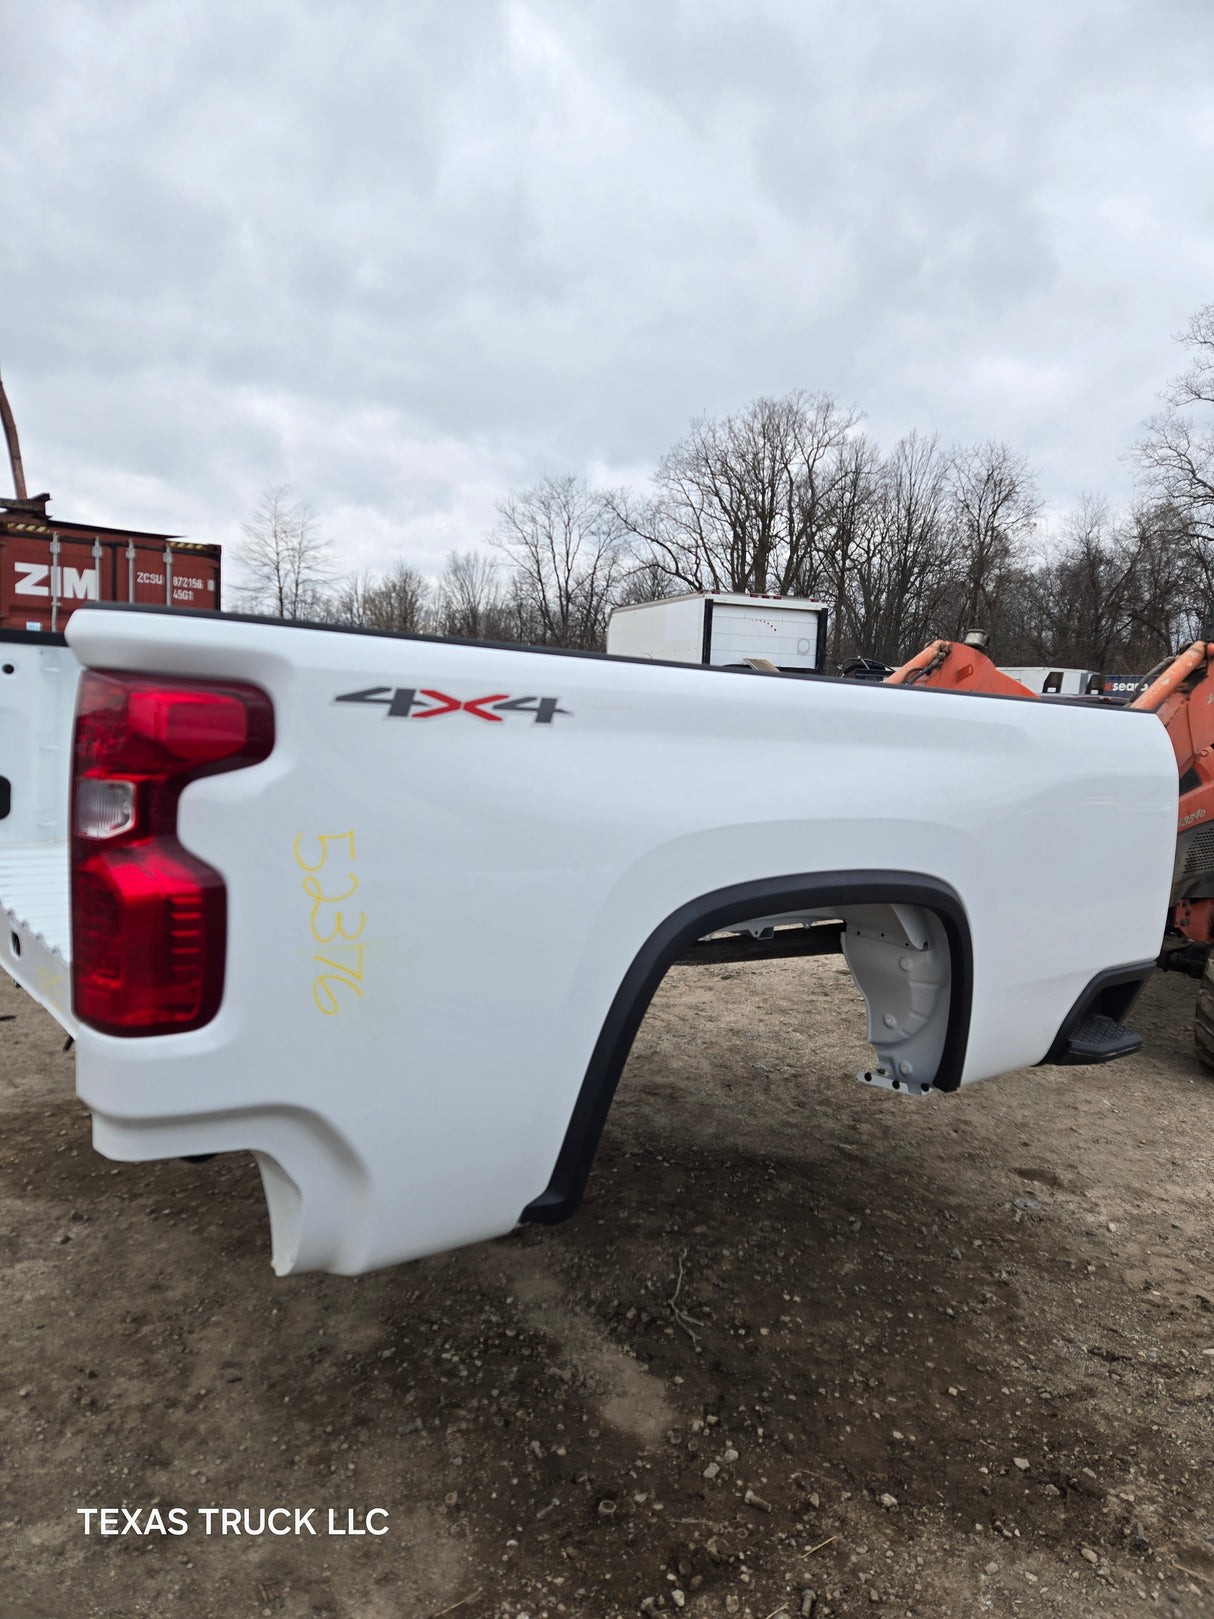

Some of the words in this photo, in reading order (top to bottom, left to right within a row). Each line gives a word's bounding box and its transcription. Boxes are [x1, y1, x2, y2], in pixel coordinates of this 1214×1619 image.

[14, 561, 98, 600] ZIM
[136, 571, 164, 585] ZCSU
[293, 829, 366, 1016] 52376
